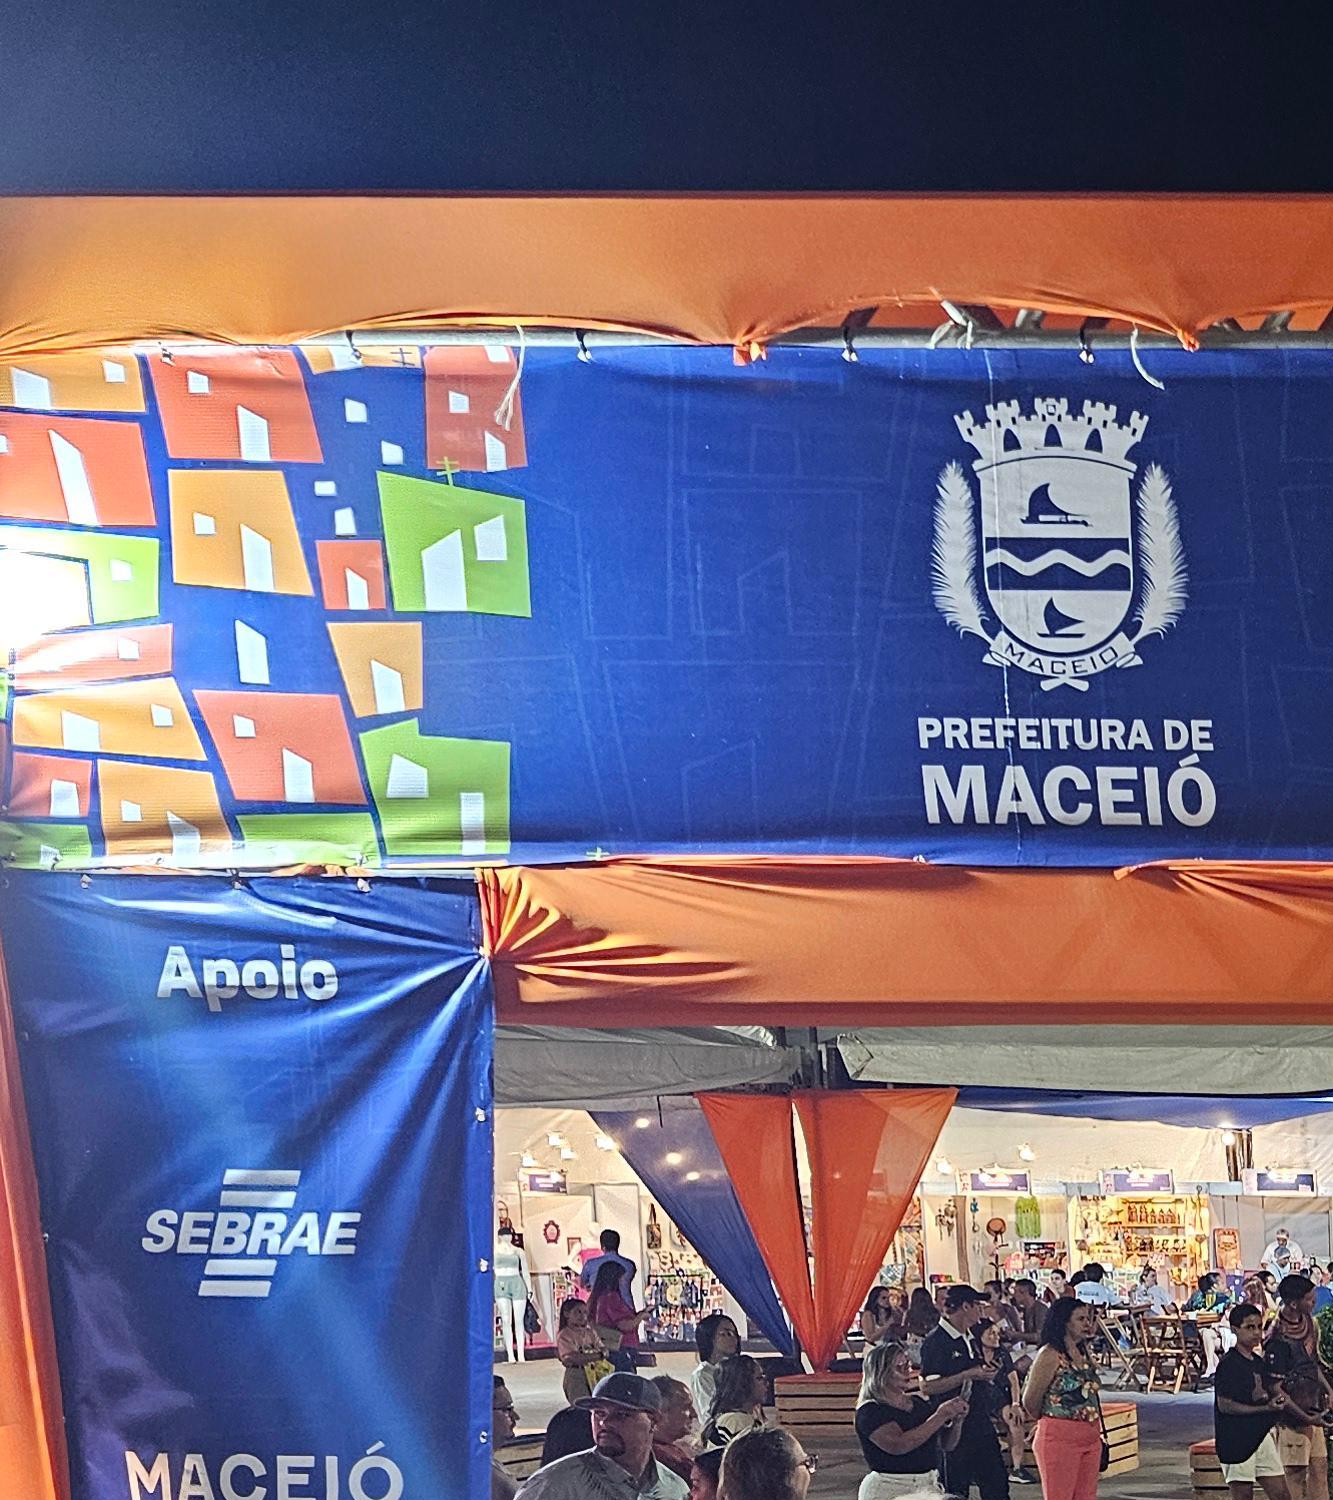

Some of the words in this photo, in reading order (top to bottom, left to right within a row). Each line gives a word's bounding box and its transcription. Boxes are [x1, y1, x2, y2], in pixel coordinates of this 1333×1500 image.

[1003, 641, 1119, 676] MACEIO
[917, 717, 1154, 751] PREFEITURA
[1163, 719, 1214, 752] DE
[921, 753, 1217, 828] MACEIÓ
[156, 944, 340, 1013] Apoio
[141, 1209, 362, 1256] SEBRAE
